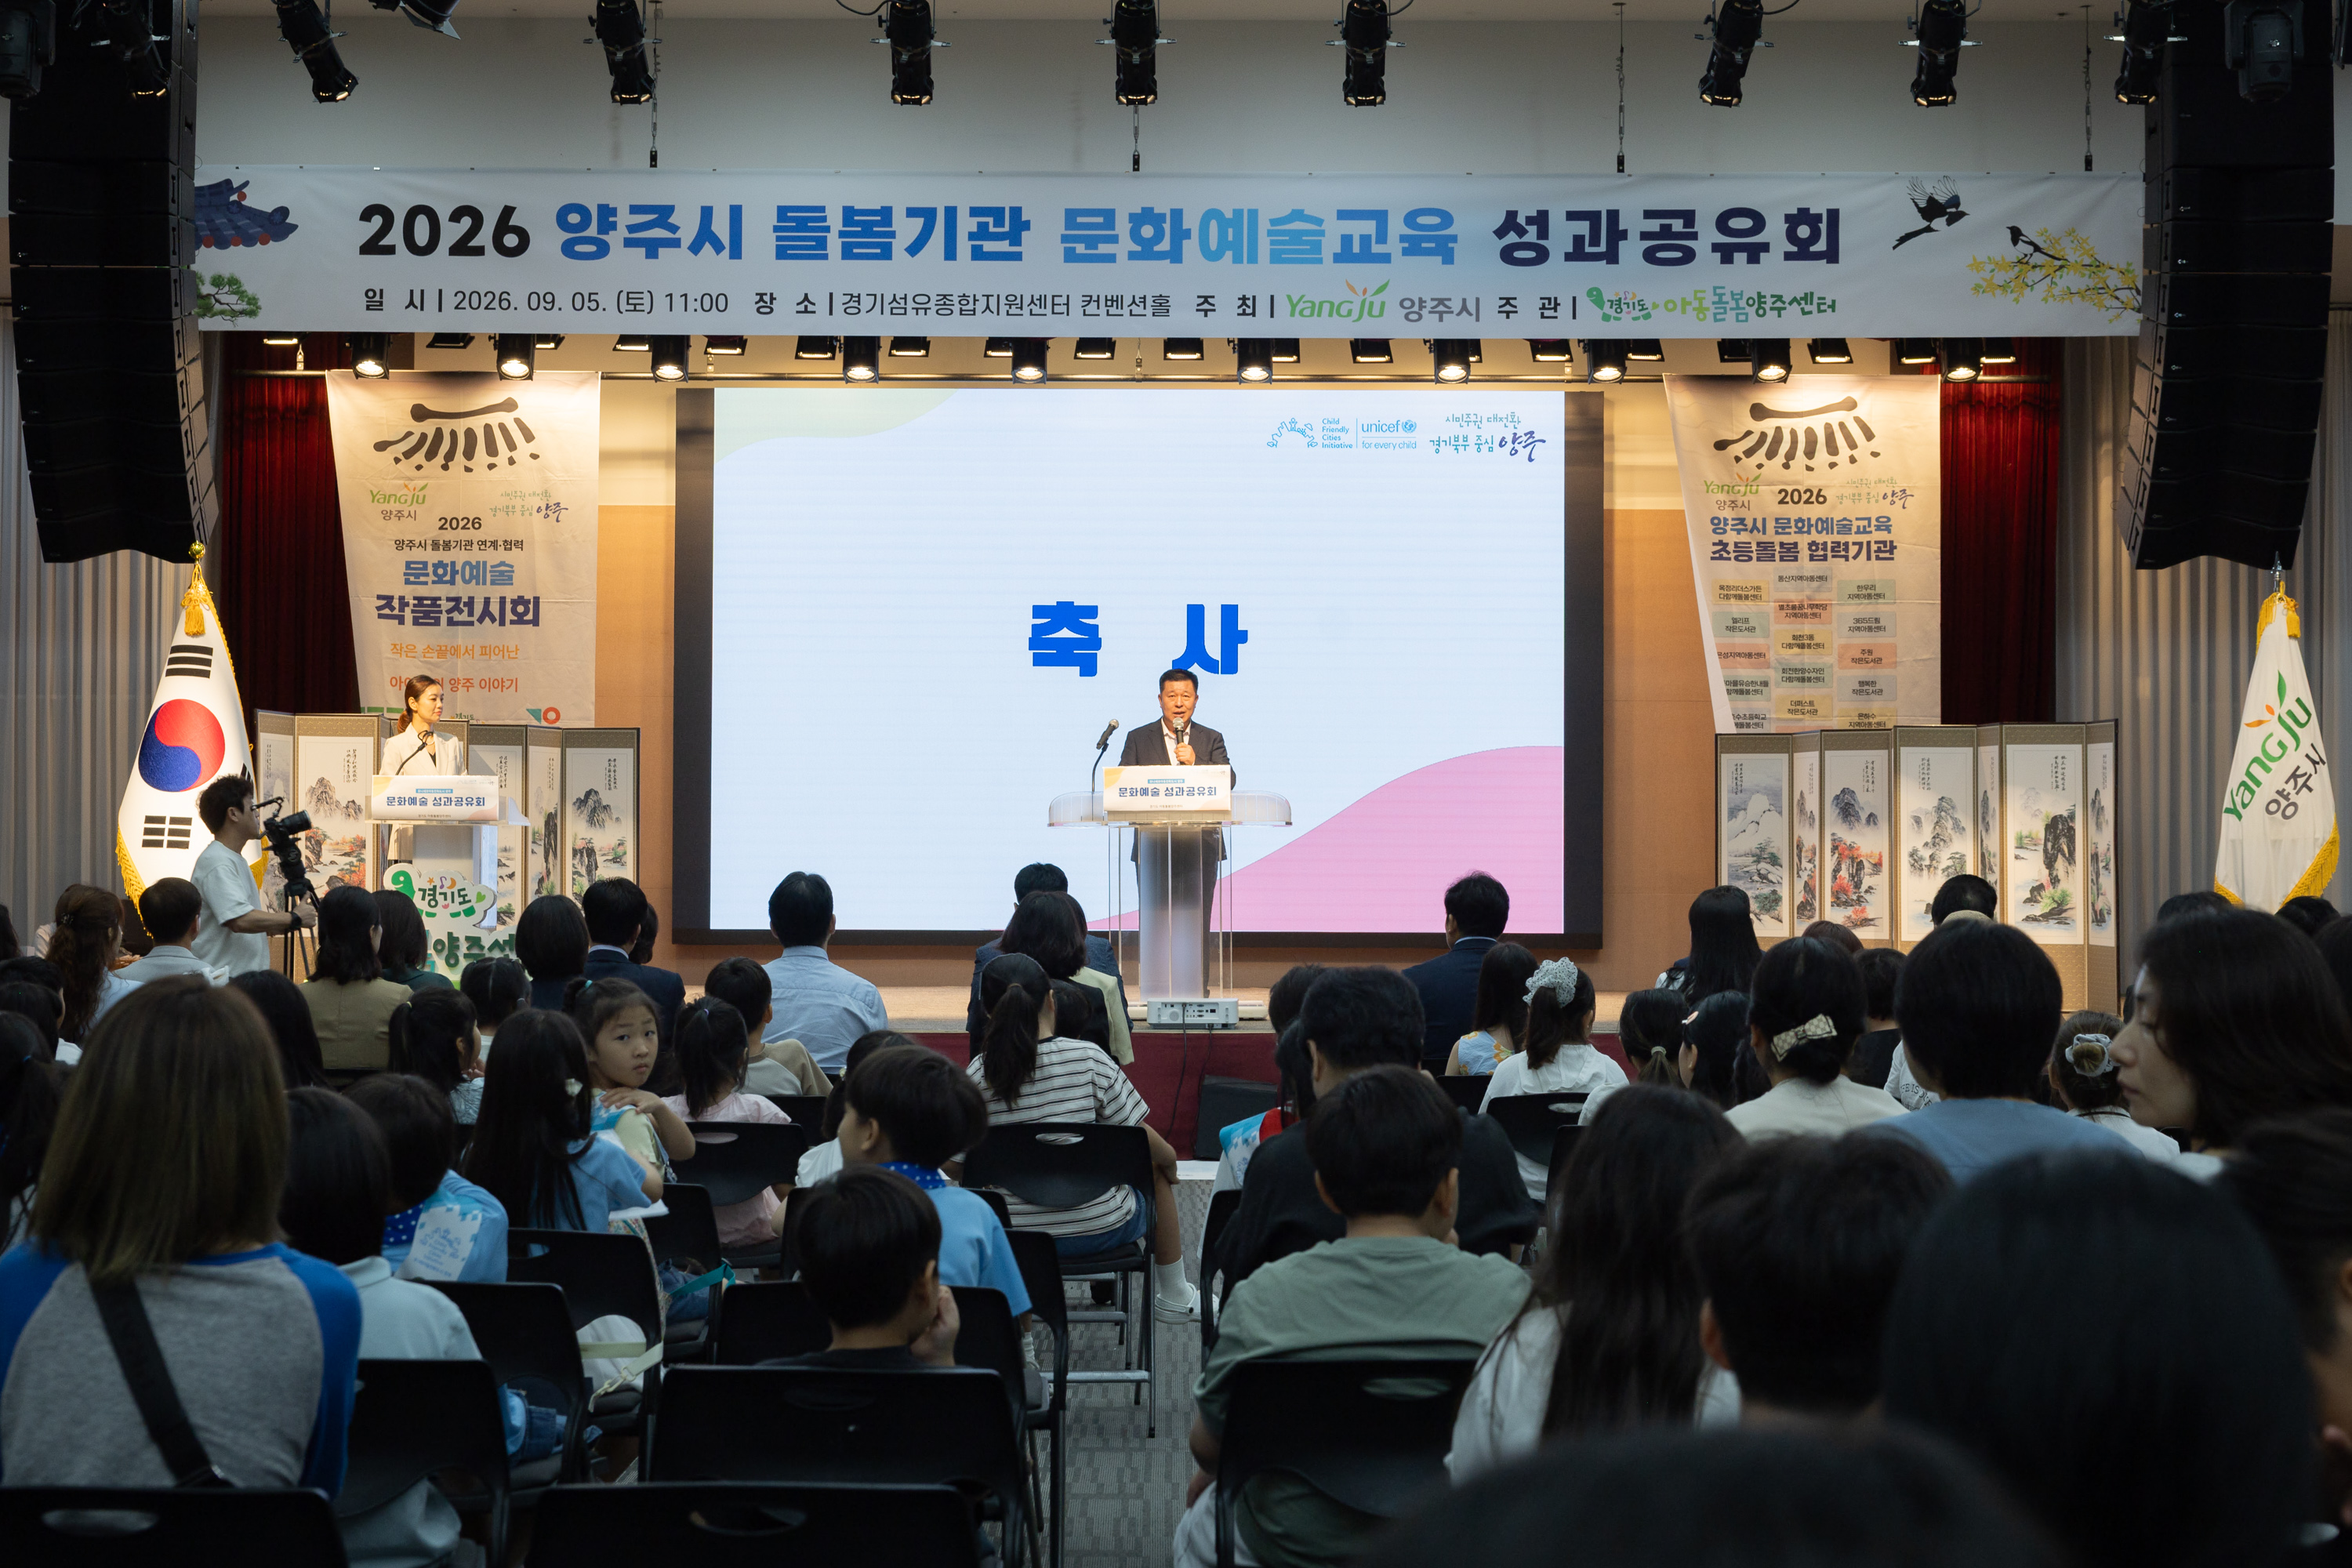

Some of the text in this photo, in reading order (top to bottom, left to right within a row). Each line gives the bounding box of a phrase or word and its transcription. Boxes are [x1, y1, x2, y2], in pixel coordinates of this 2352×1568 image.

[358, 203, 1840, 267] 2026 양주시 돌봄기관 문화예술교육 성과공유회
[453, 291, 518, 311] 2026.
[527, 292, 563, 311] 09.
[572, 292, 607, 312] 05.
[617, 289, 655, 314] (토)
[664, 292, 729, 313] 11:00
[841, 292, 1071, 317] 경기섬유종합지원센터
[1080, 293, 1172, 318] 컨벤션홀
[1399, 296, 1480, 322] 양주시
[1607, 297, 1649, 314] 경기도
[1664, 285, 1836, 323] 아동돌봄양주센터
[1362, 419, 1400, 433] unicef
[1446, 412, 1521, 430] 시민주권 대전환
[1362, 441, 1417, 451] for every child
[1429, 430, 1546, 463] 경기북부 중심 양주
[1715, 499, 1751, 511] 양주시
[1777, 488, 1828, 505] 2026
[1835, 488, 1915, 510] 경기북부 중심 양주
[381, 510, 417, 521] 양주시
[489, 502, 568, 523] 경기북부 중심 양주
[437, 516, 483, 531] 2026
[1710, 515, 1893, 535] 양주시 문화예술교육
[394, 539, 524, 552] 양주시 돌봄기관 연계·협력
[1710, 539, 1897, 562] 초등돌봄 협력기관
[403, 560, 515, 586] 문화예술
[1719, 584, 1762, 593] 옥정리더스가든
[375, 593, 540, 628] 작품전시회
[390, 643, 520, 659] 작은 손끝에서 피어난
[448, 677, 475, 692] 양주
[479, 677, 518, 693] 이야기
[1848, 720, 1886, 729] 지역아동센터
[2265, 742, 2326, 820] 양주시
[1119, 786, 1217, 797] 문화예술 성과공유회
[387, 796, 485, 807] 문화예술 성과공유회
[418, 885, 472, 908] 경기도
